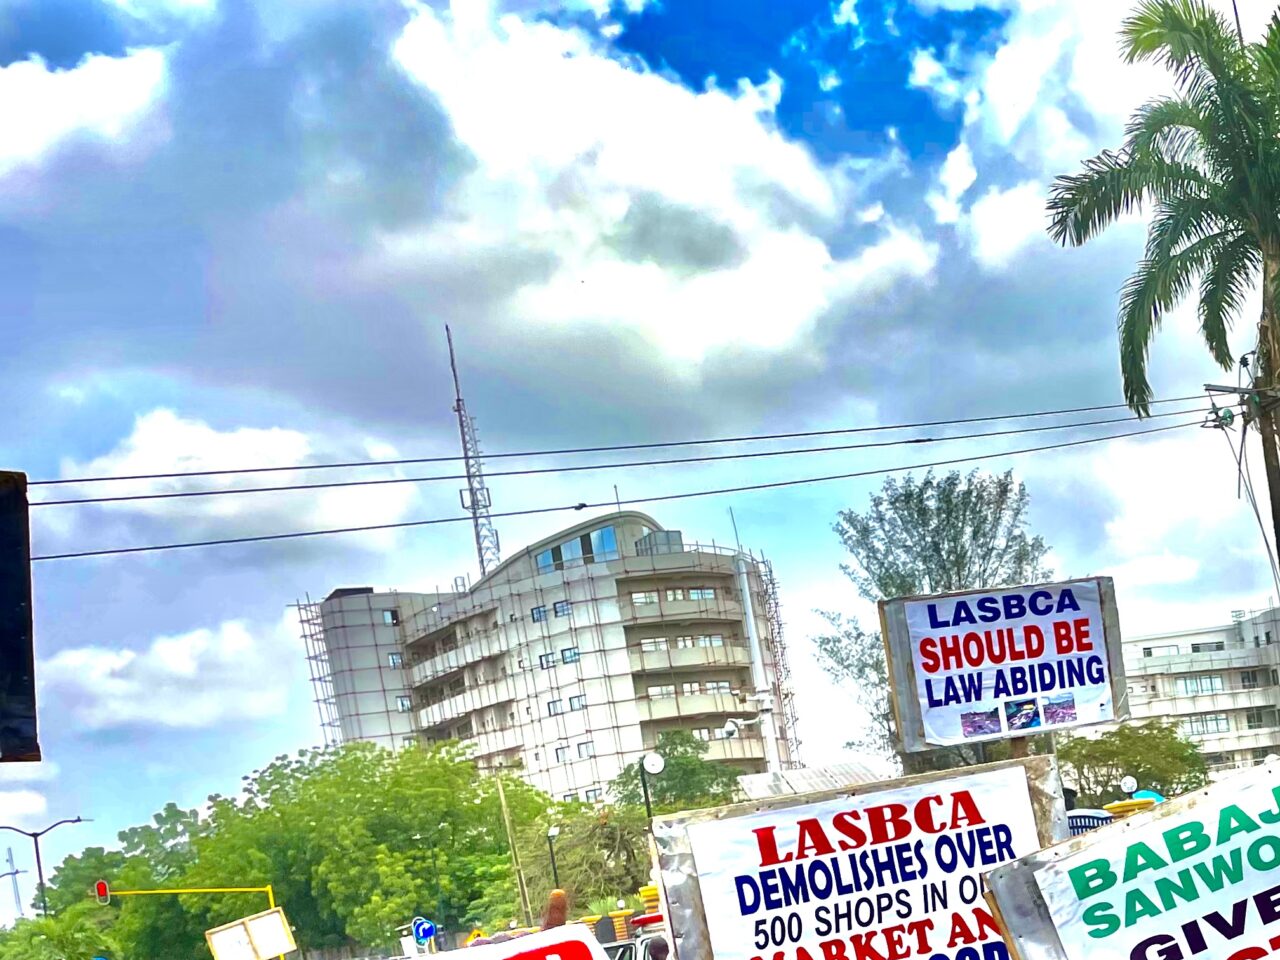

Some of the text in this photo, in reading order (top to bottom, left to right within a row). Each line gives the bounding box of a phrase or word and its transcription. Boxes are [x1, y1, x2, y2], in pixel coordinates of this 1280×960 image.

[927, 588, 1080, 629] LASBCA
[919, 618, 1093, 674] SHOULD BE
[925, 655, 1105, 708] LAW ABIDING
[752, 790, 987, 867] LASBCA
[734, 823, 1016, 916] DEMOLISHES OVER
[754, 911, 803, 950] 500
[814, 888, 912, 936] SHOPS
[922, 879, 949, 914] IN
